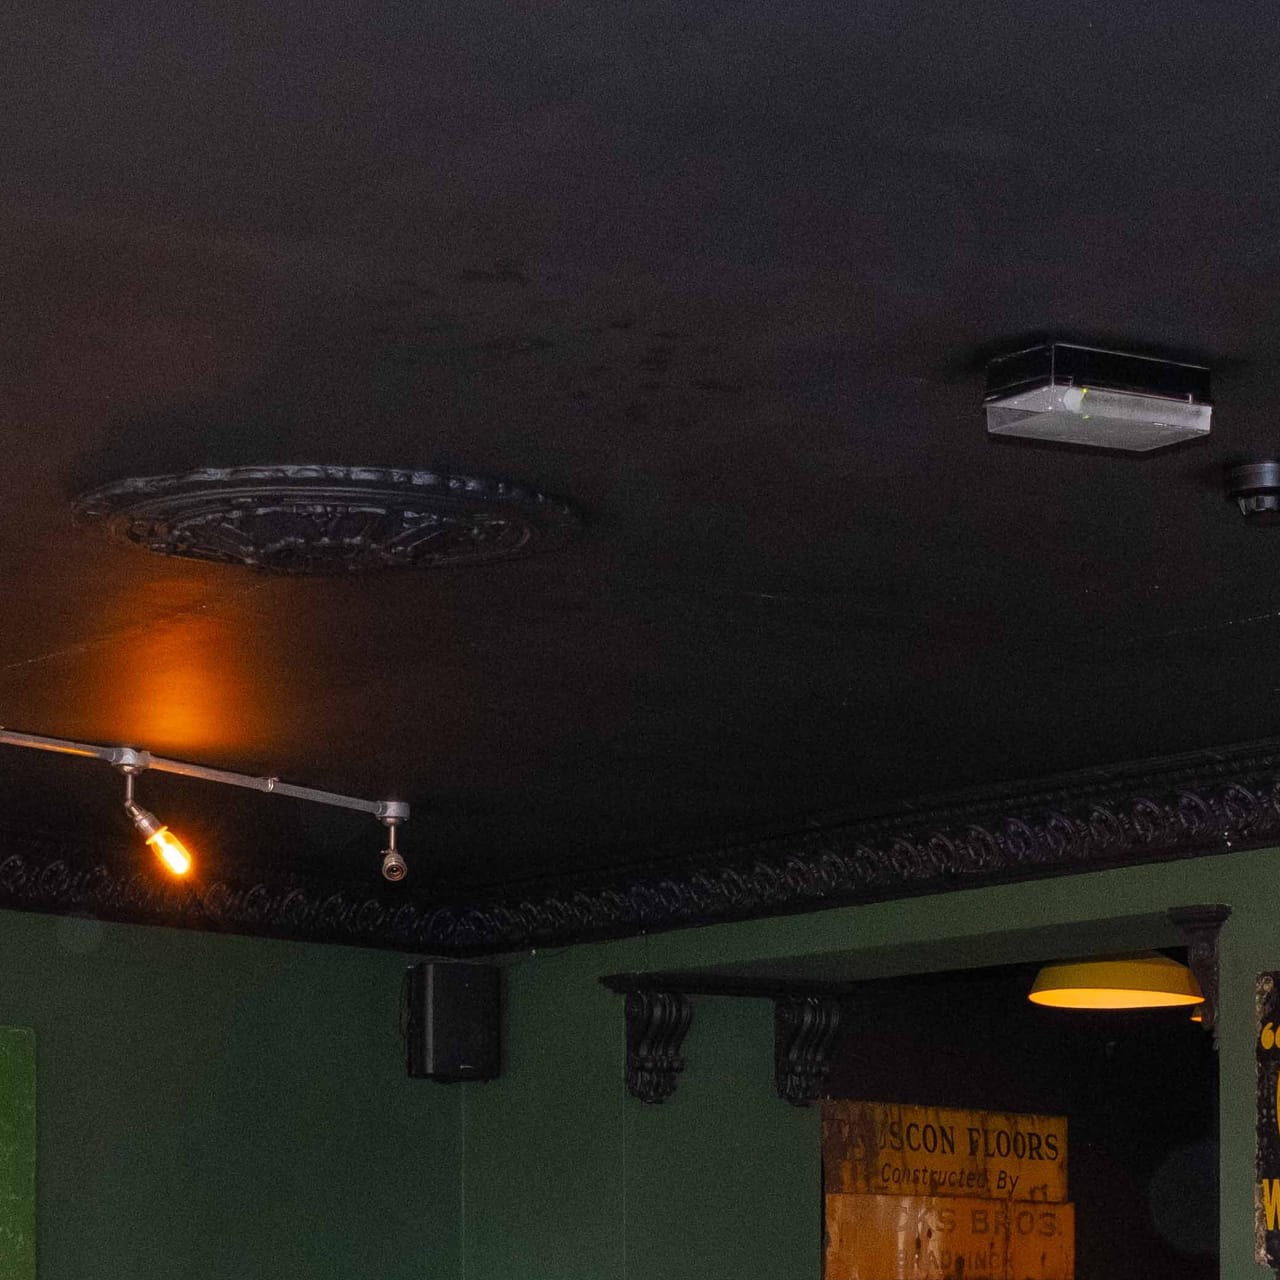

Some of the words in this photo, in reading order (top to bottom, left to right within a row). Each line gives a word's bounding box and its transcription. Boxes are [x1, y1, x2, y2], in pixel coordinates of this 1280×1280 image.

[966, 1127, 1059, 1161] FLOORS
[881, 1162, 988, 1190] Constructed
[996, 1169, 1019, 1198] By
